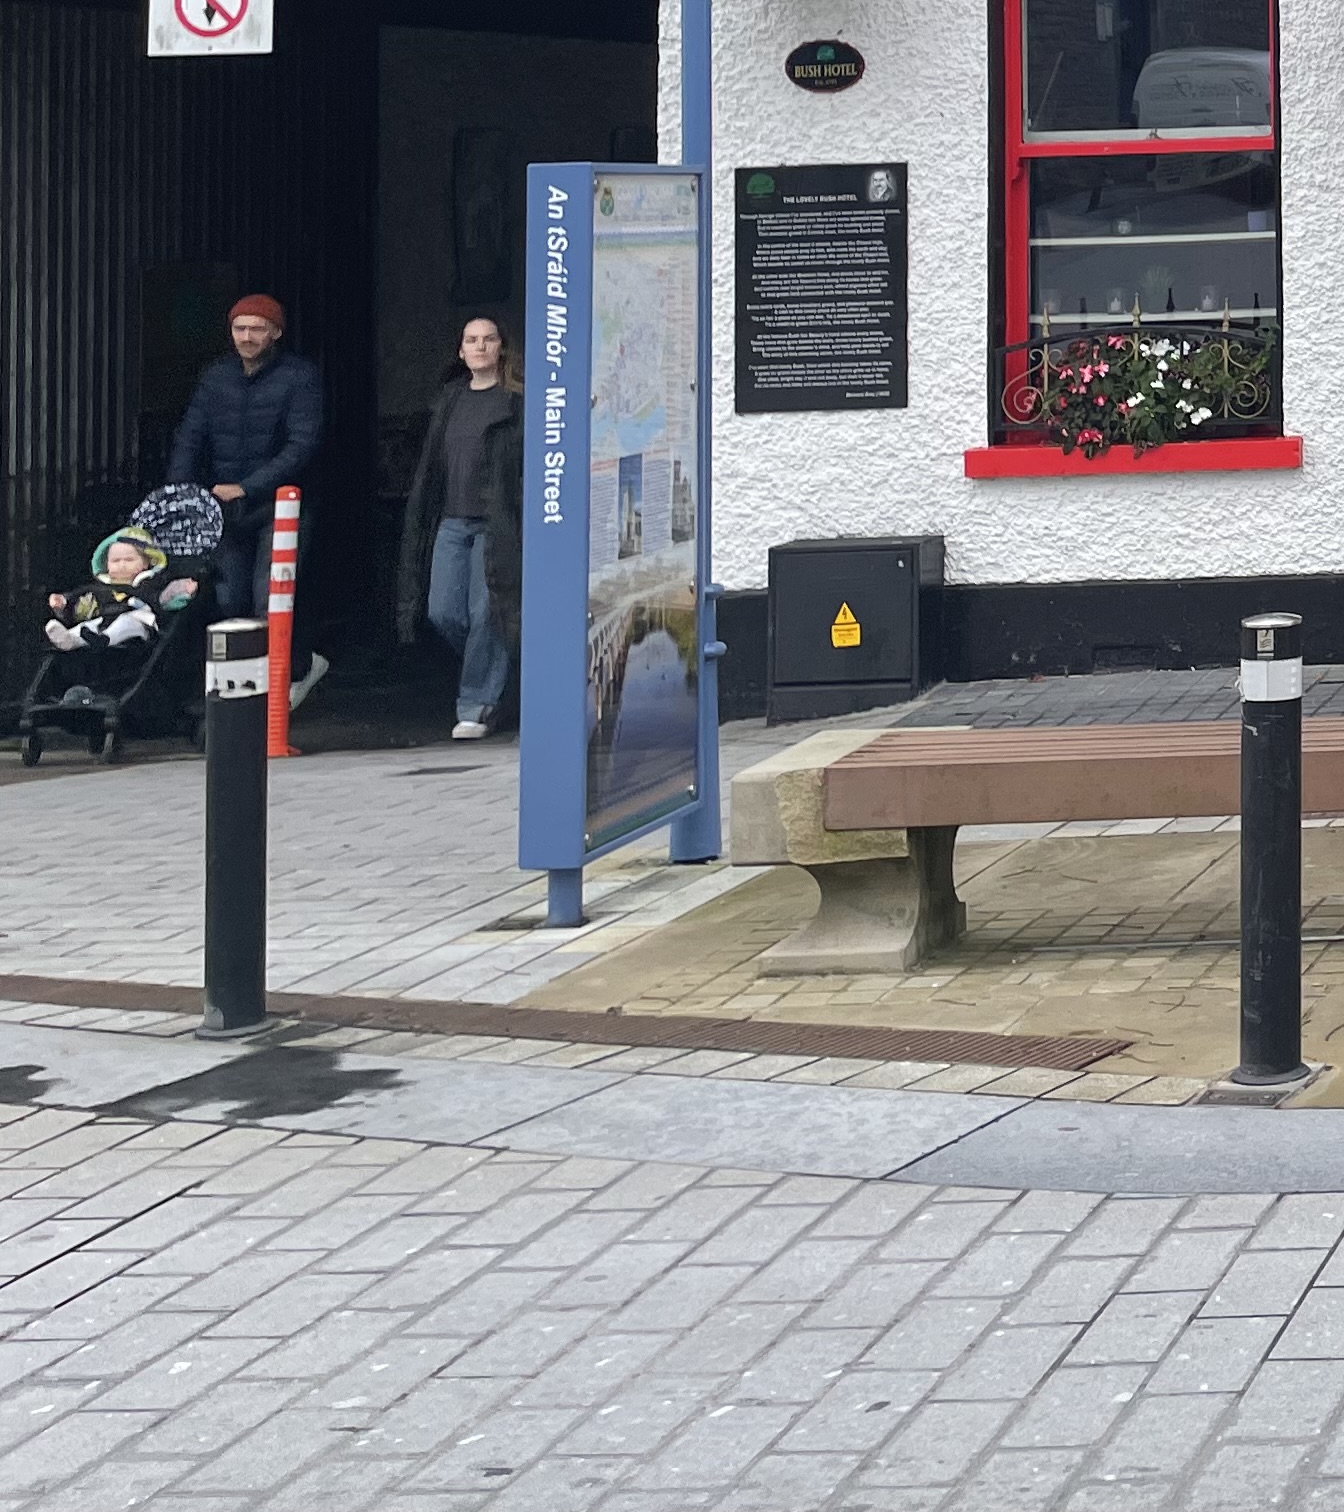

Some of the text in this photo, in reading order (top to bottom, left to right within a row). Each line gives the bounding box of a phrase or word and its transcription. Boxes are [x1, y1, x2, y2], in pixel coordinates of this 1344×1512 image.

[794, 63, 858, 78] BUSH HOTEL
[547, 184, 569, 220] An
[547, 226, 569, 299] tSráid
[546, 303, 568, 368] Mhór
[545, 387, 567, 445] Main
[543, 451, 566, 524] Street
